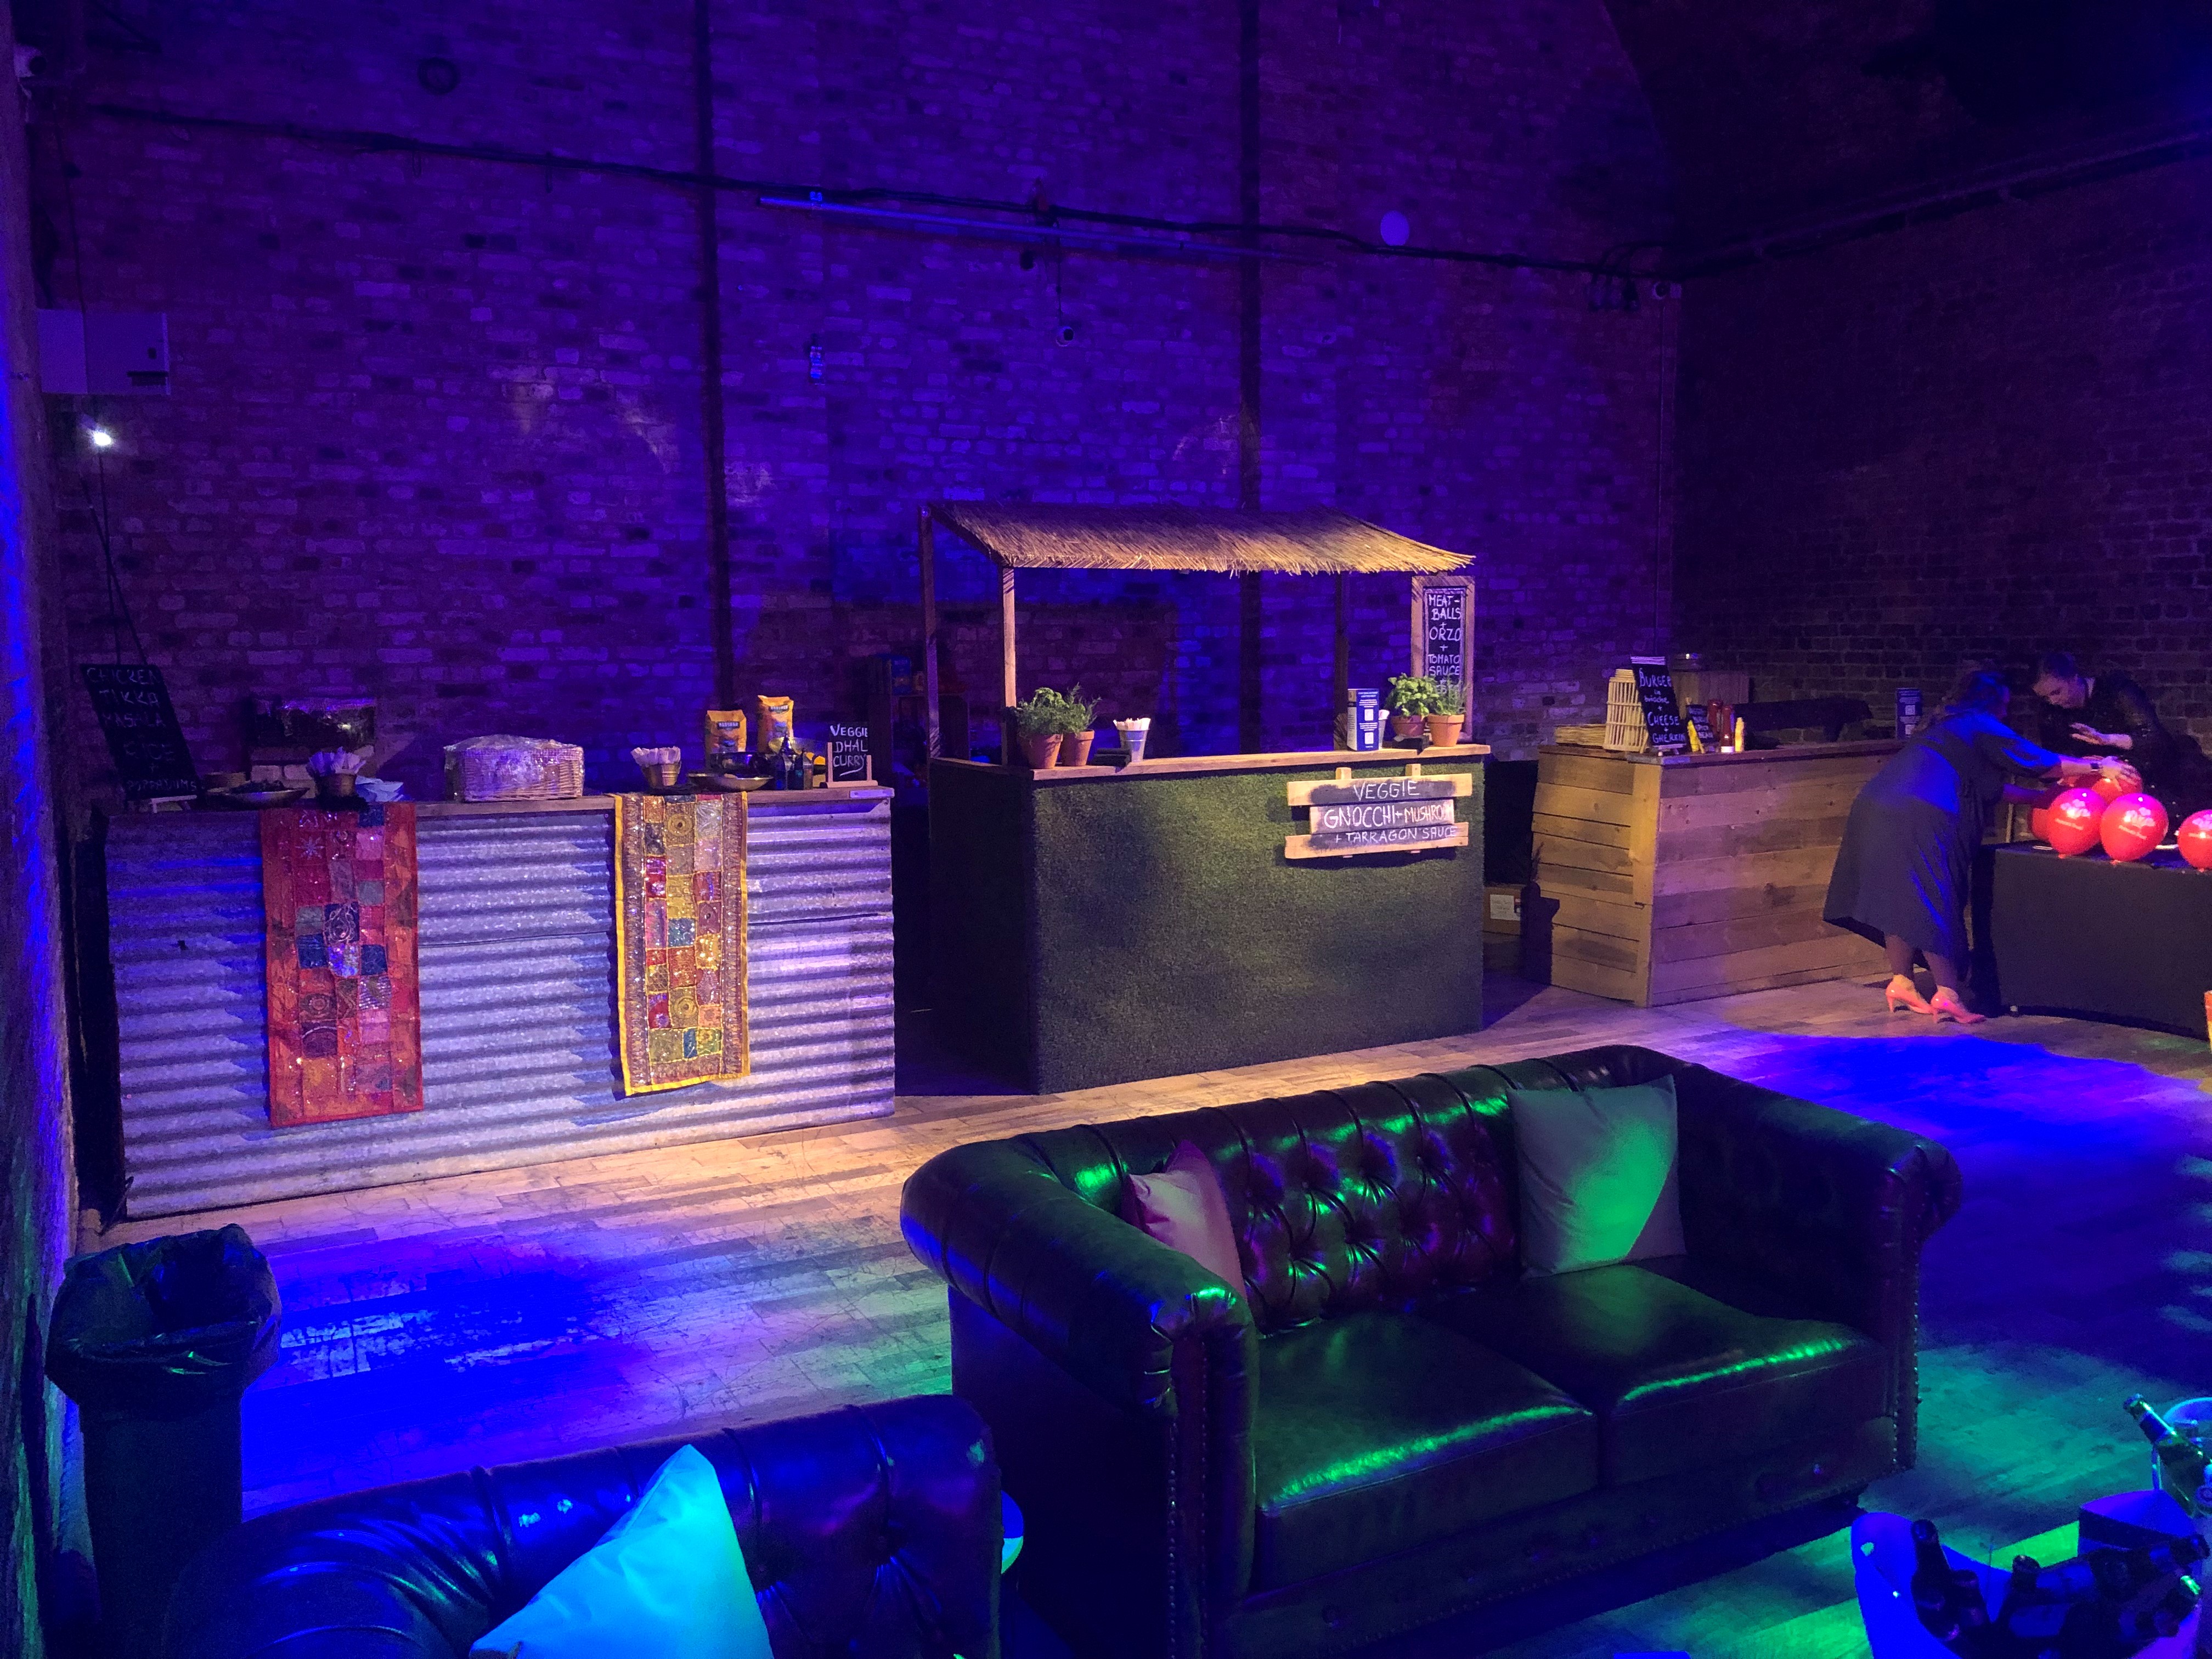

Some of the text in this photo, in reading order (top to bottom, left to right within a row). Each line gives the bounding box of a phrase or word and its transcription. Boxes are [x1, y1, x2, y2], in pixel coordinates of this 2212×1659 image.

[1431, 607, 1461, 620] BALLS
[1430, 627, 1460, 641] ORZO
[1428, 654, 1460, 664] TOMATO
[1429, 665, 1460, 676] SAUCE
[99, 689, 160, 708] TIKKA
[102, 712, 166, 728] MASLA
[1647, 712, 1680, 726] CHEESE
[830, 724, 868, 737] VEGGIE
[833, 738, 868, 753] DHAL
[833, 754, 866, 774] CURRY
[1353, 780, 1420, 801] VEGGIE
[1346, 827, 1417, 844] TARRAGON
[1422, 826, 1458, 839] SAUCE
